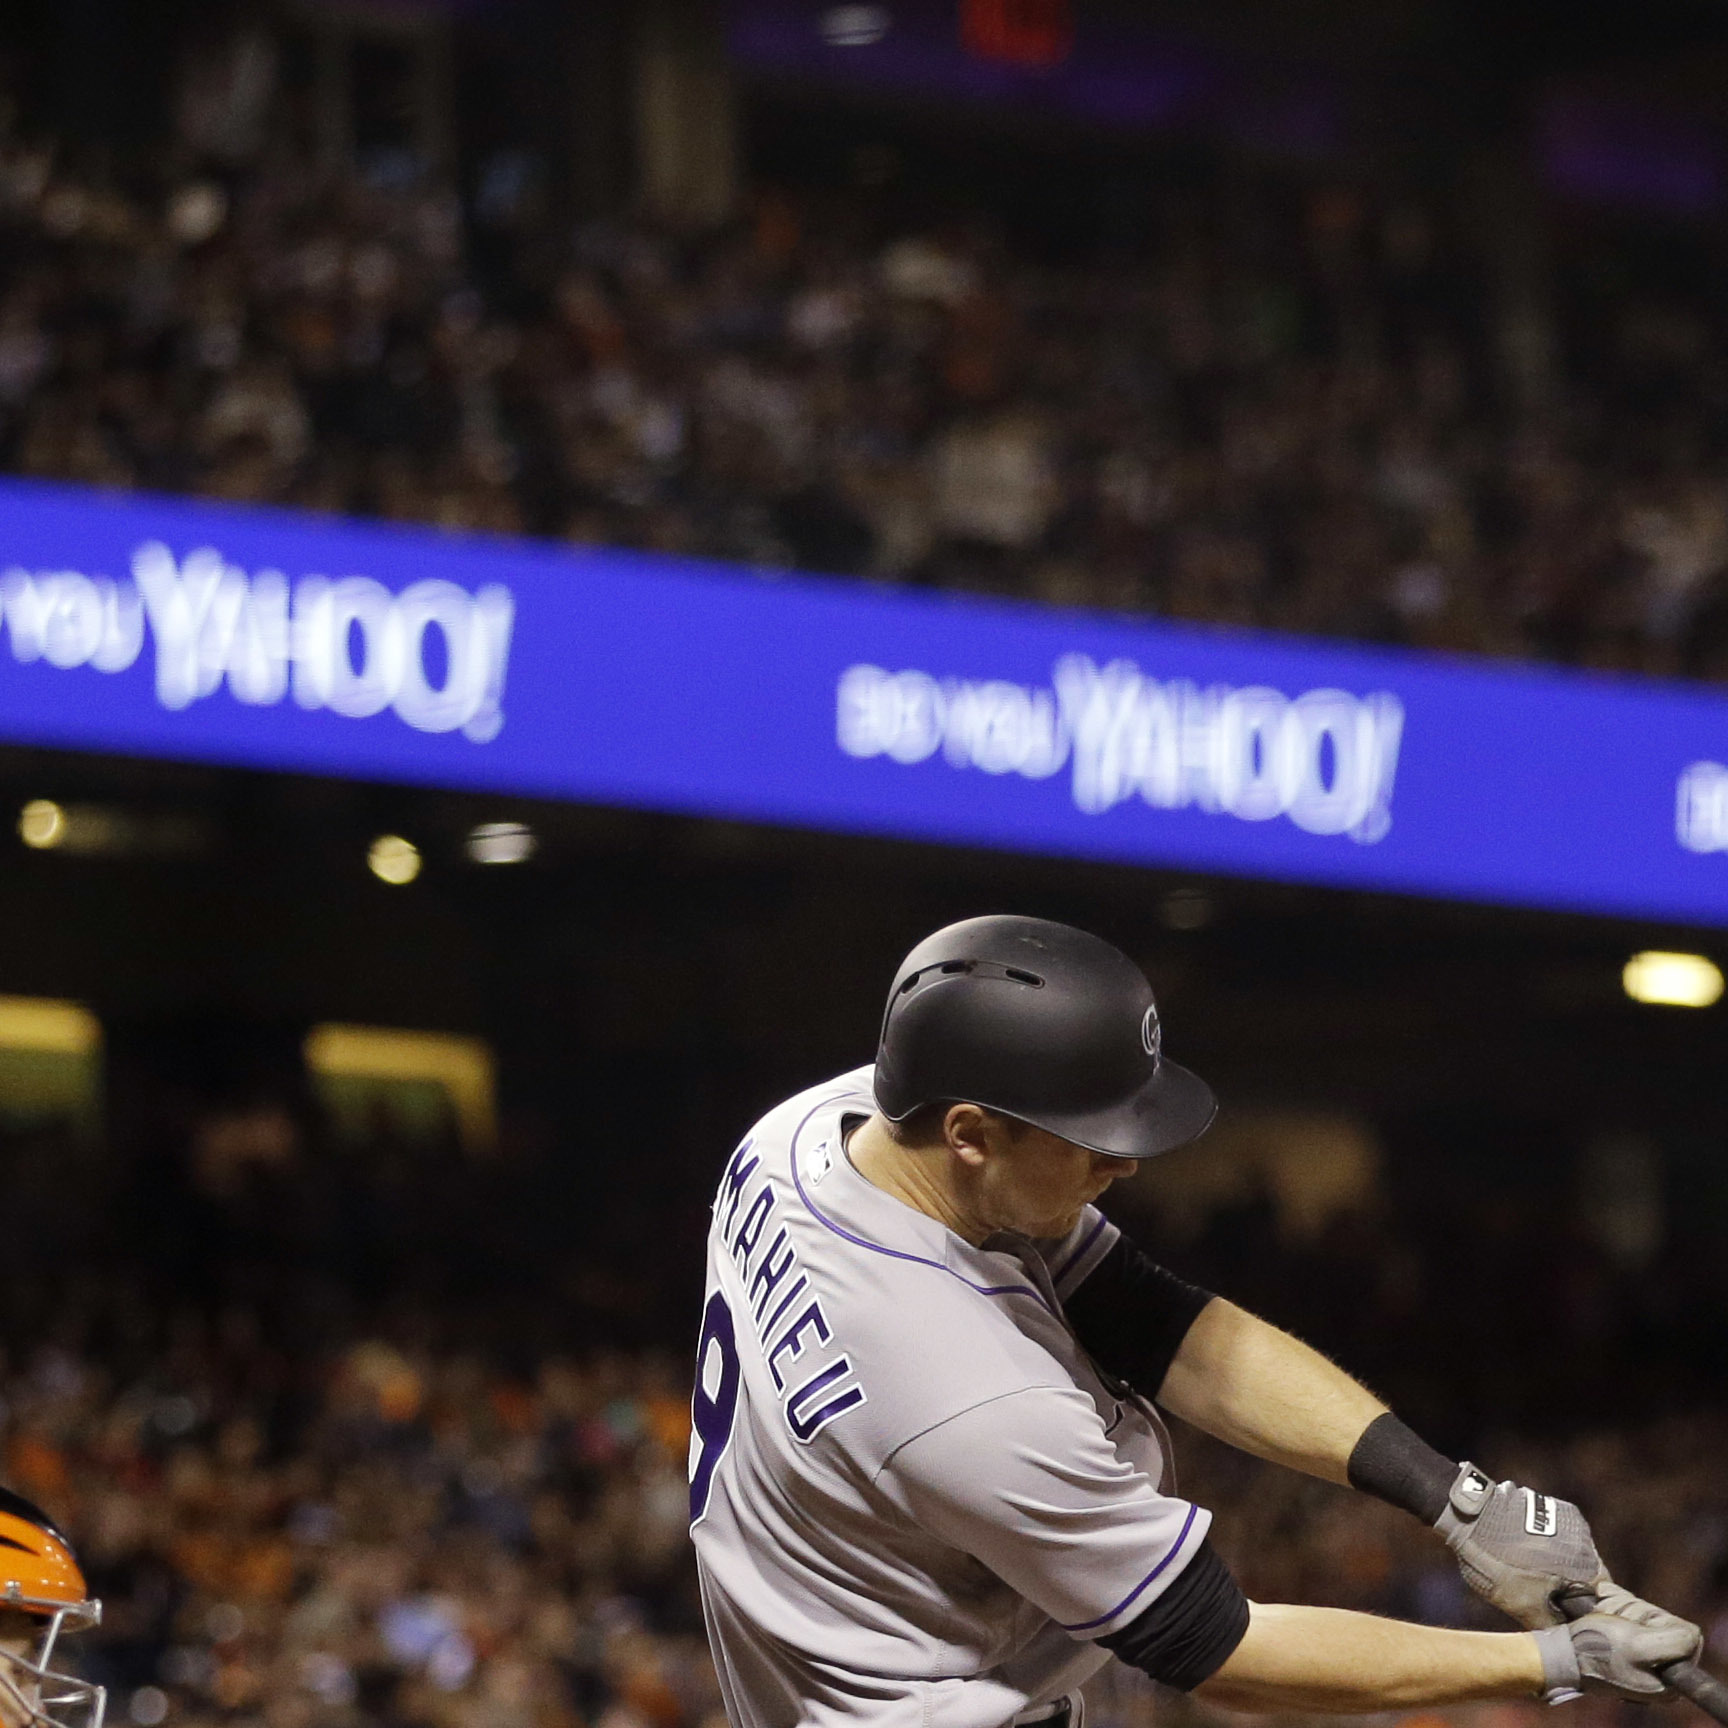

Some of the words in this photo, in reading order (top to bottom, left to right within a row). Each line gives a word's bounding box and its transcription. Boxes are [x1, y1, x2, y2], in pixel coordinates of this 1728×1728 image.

[1, 566, 144, 674] YOU
[131, 540, 515, 744] YAHOO!
[836, 662, 944, 765] DO
[941, 675, 1071, 780] YOU
[1051, 650, 1406, 845] YAHOO!
[689, 1287, 742, 1538] 9
